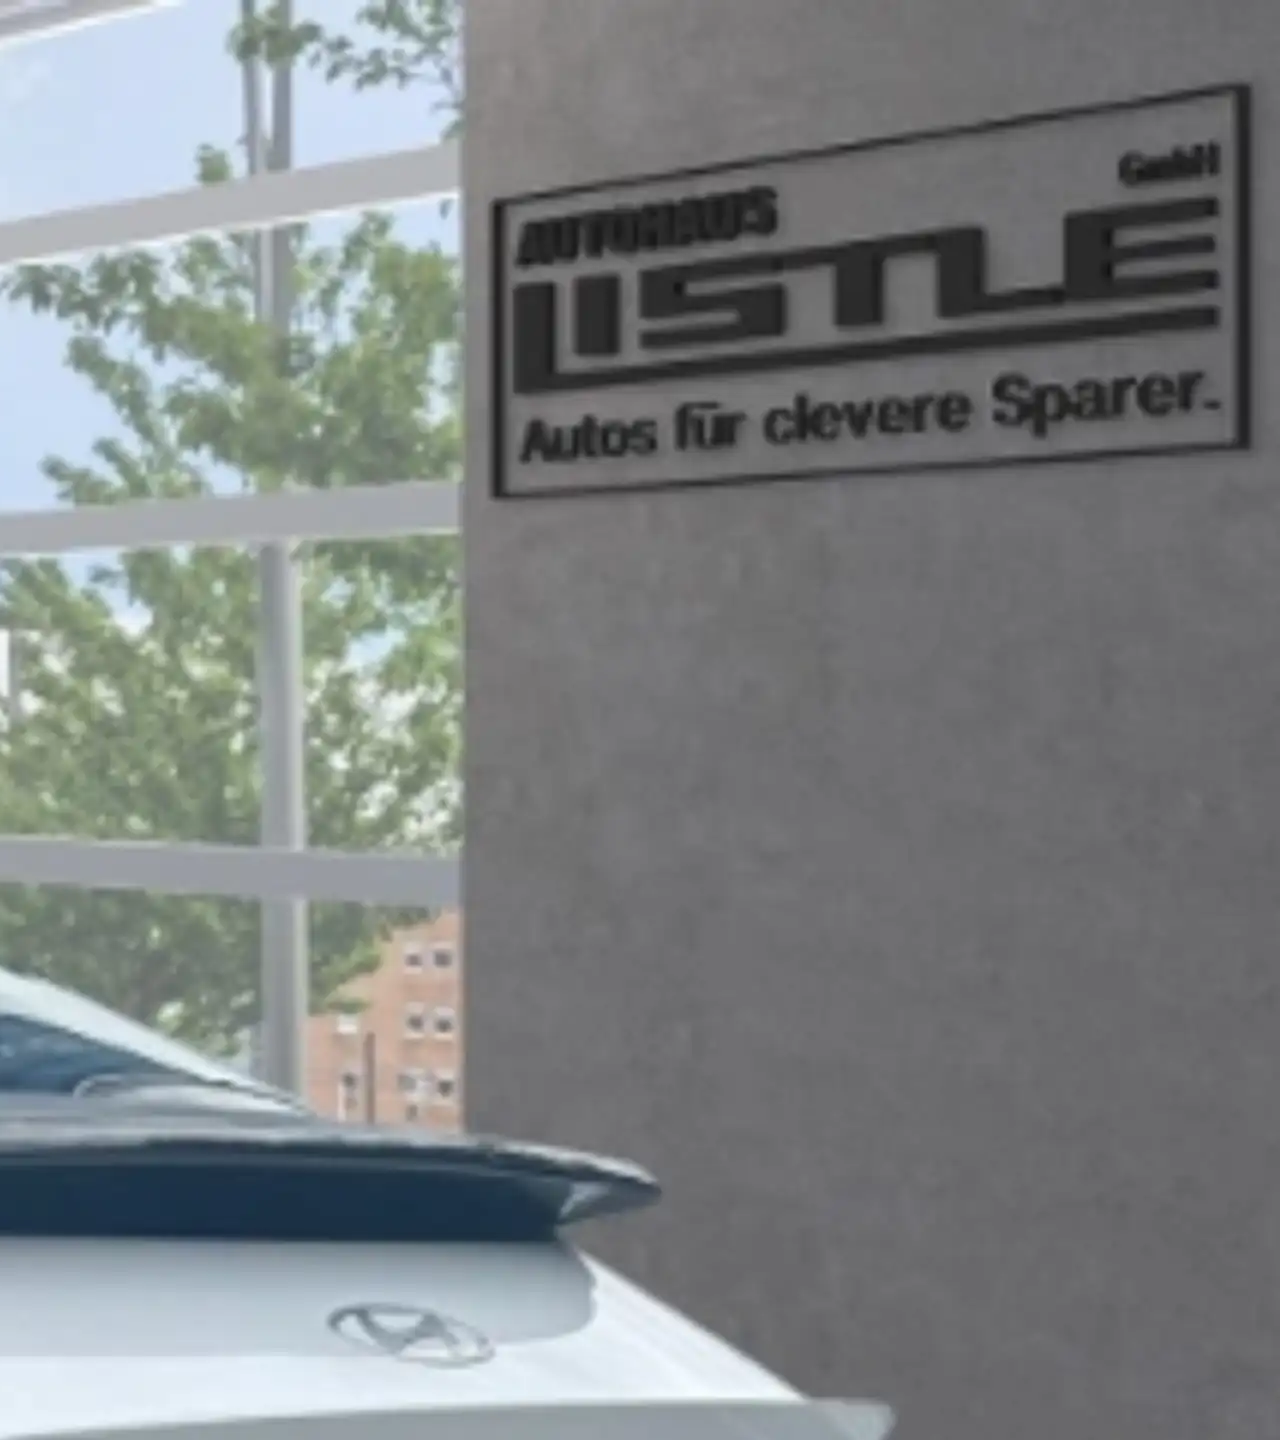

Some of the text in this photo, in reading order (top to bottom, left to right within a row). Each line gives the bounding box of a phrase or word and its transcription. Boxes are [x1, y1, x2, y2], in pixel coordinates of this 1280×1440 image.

[1117, 141, 1221, 188] GmbH
[514, 185, 778, 268] AUTOHAUS
[520, 370, 1222, 463] Autos für clevere Sparer.
